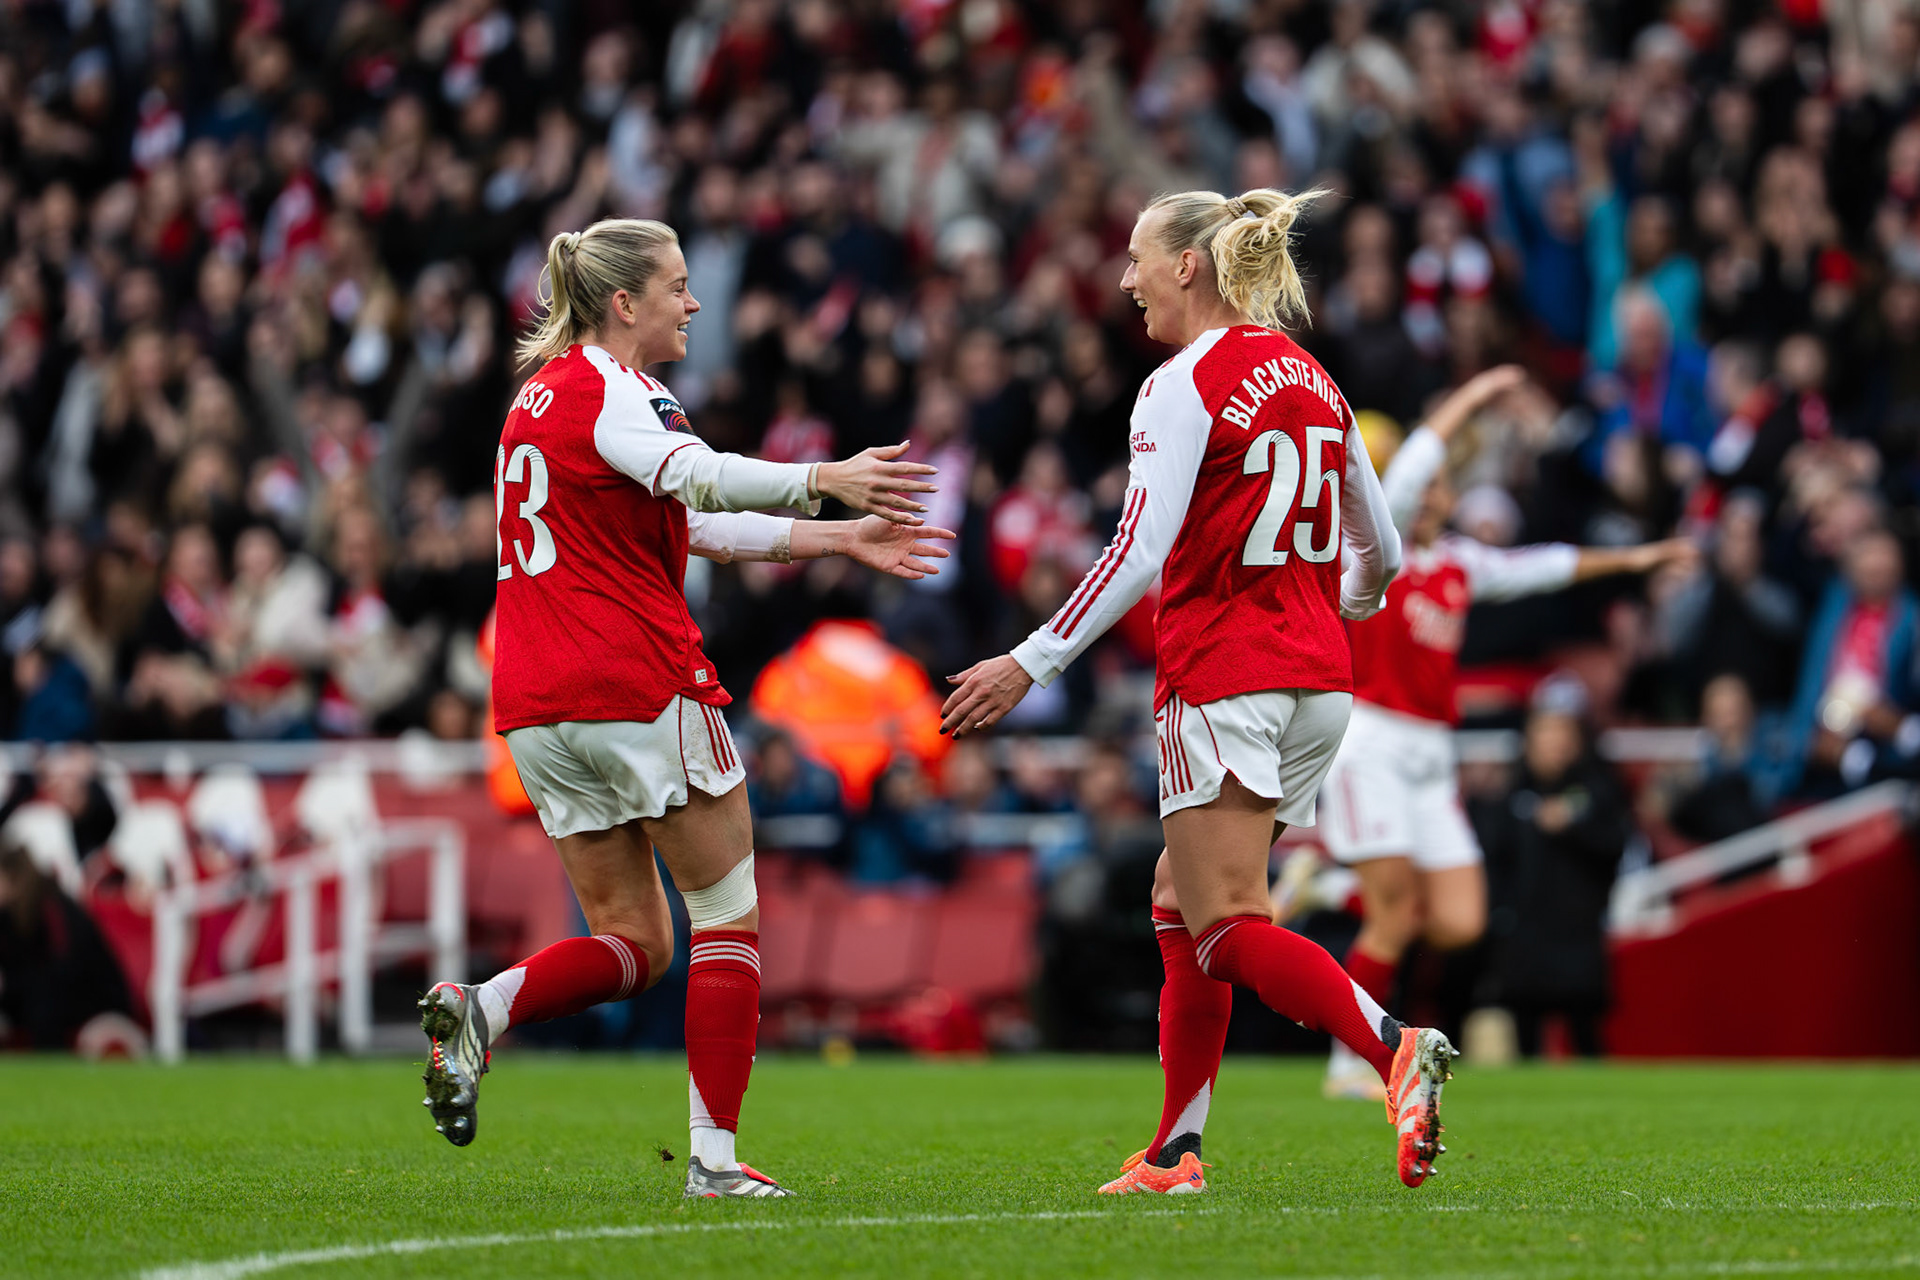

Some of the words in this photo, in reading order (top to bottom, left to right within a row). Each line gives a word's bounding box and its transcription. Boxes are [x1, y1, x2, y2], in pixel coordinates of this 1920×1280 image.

[509, 382, 554, 418] SSO
[1130, 431, 1146, 444] SIT
[1132, 442, 1157, 453] NDA
[1242, 426, 1344, 566] 25
